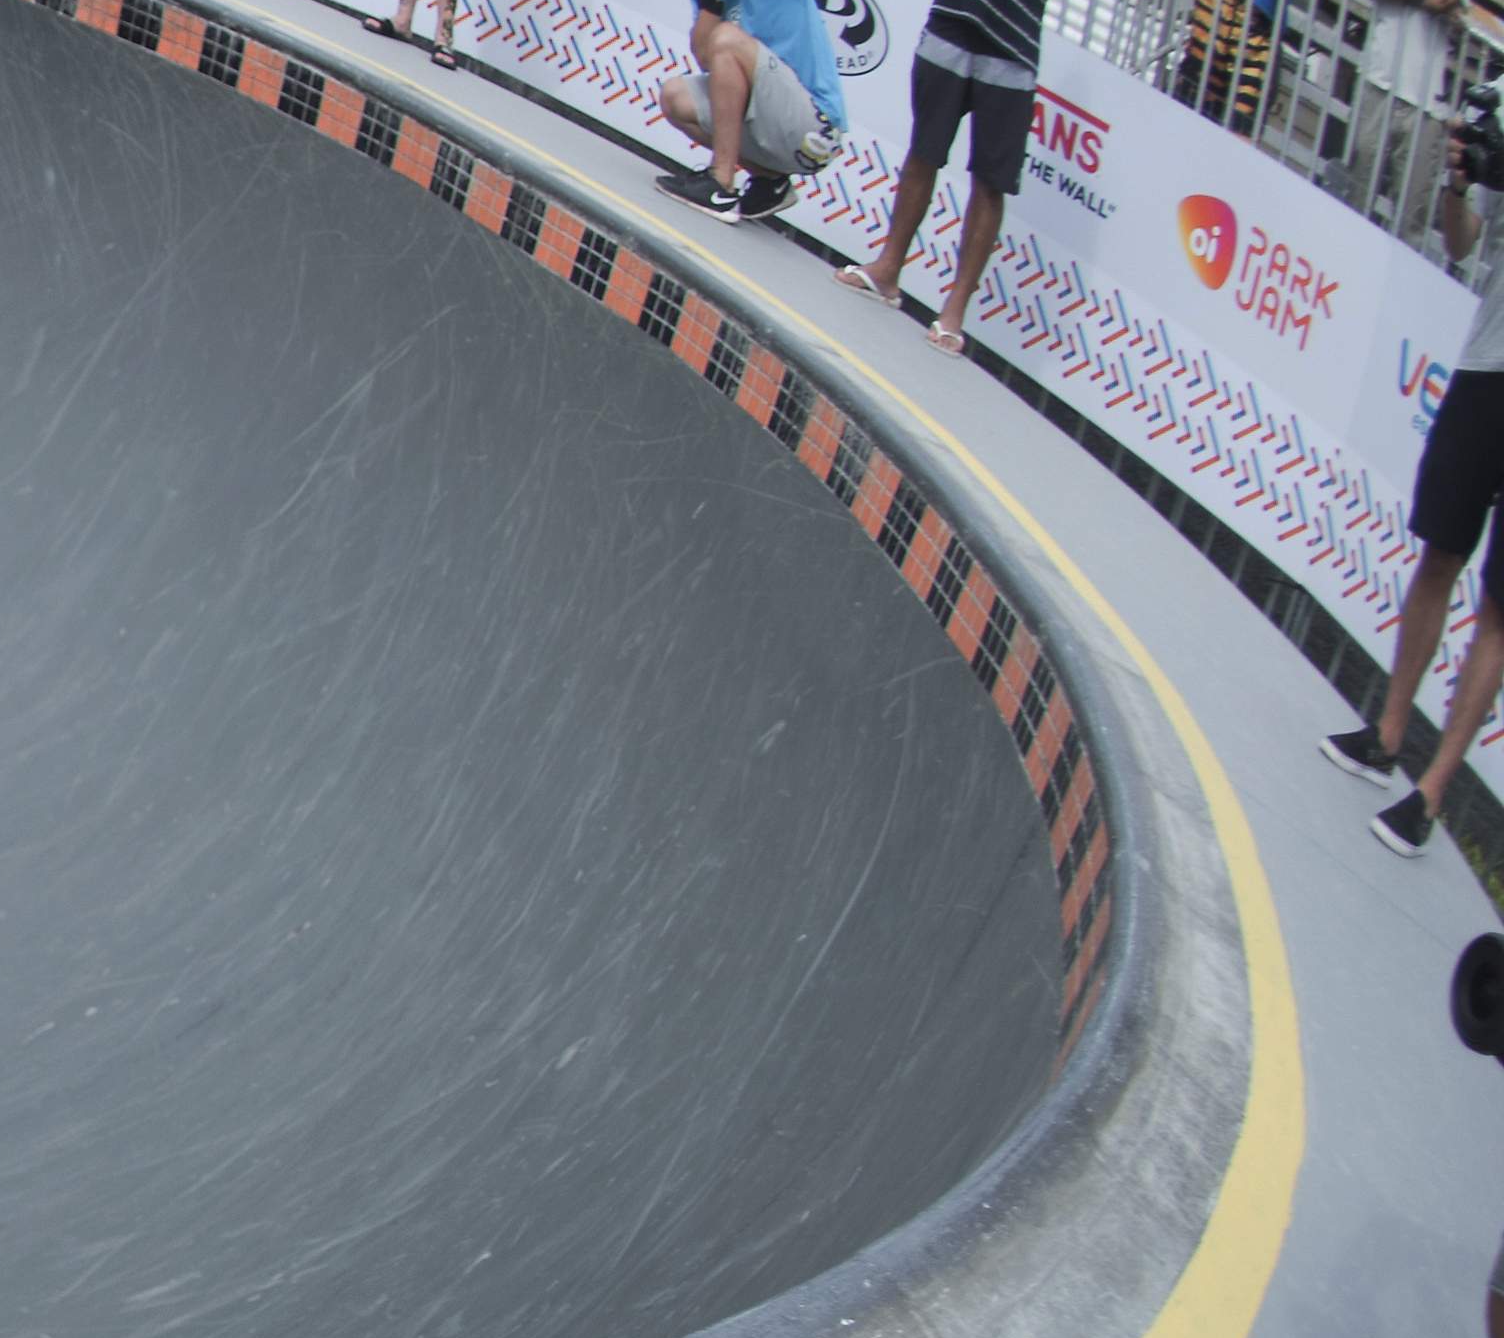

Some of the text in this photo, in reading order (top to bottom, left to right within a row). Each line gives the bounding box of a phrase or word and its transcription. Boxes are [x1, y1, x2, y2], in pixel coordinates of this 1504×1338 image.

[1028, 85, 1110, 174] ANS
[1189, 225, 1223, 265] oi
[1239, 225, 1340, 319] PARK
[1235, 264, 1312, 351] JAM
